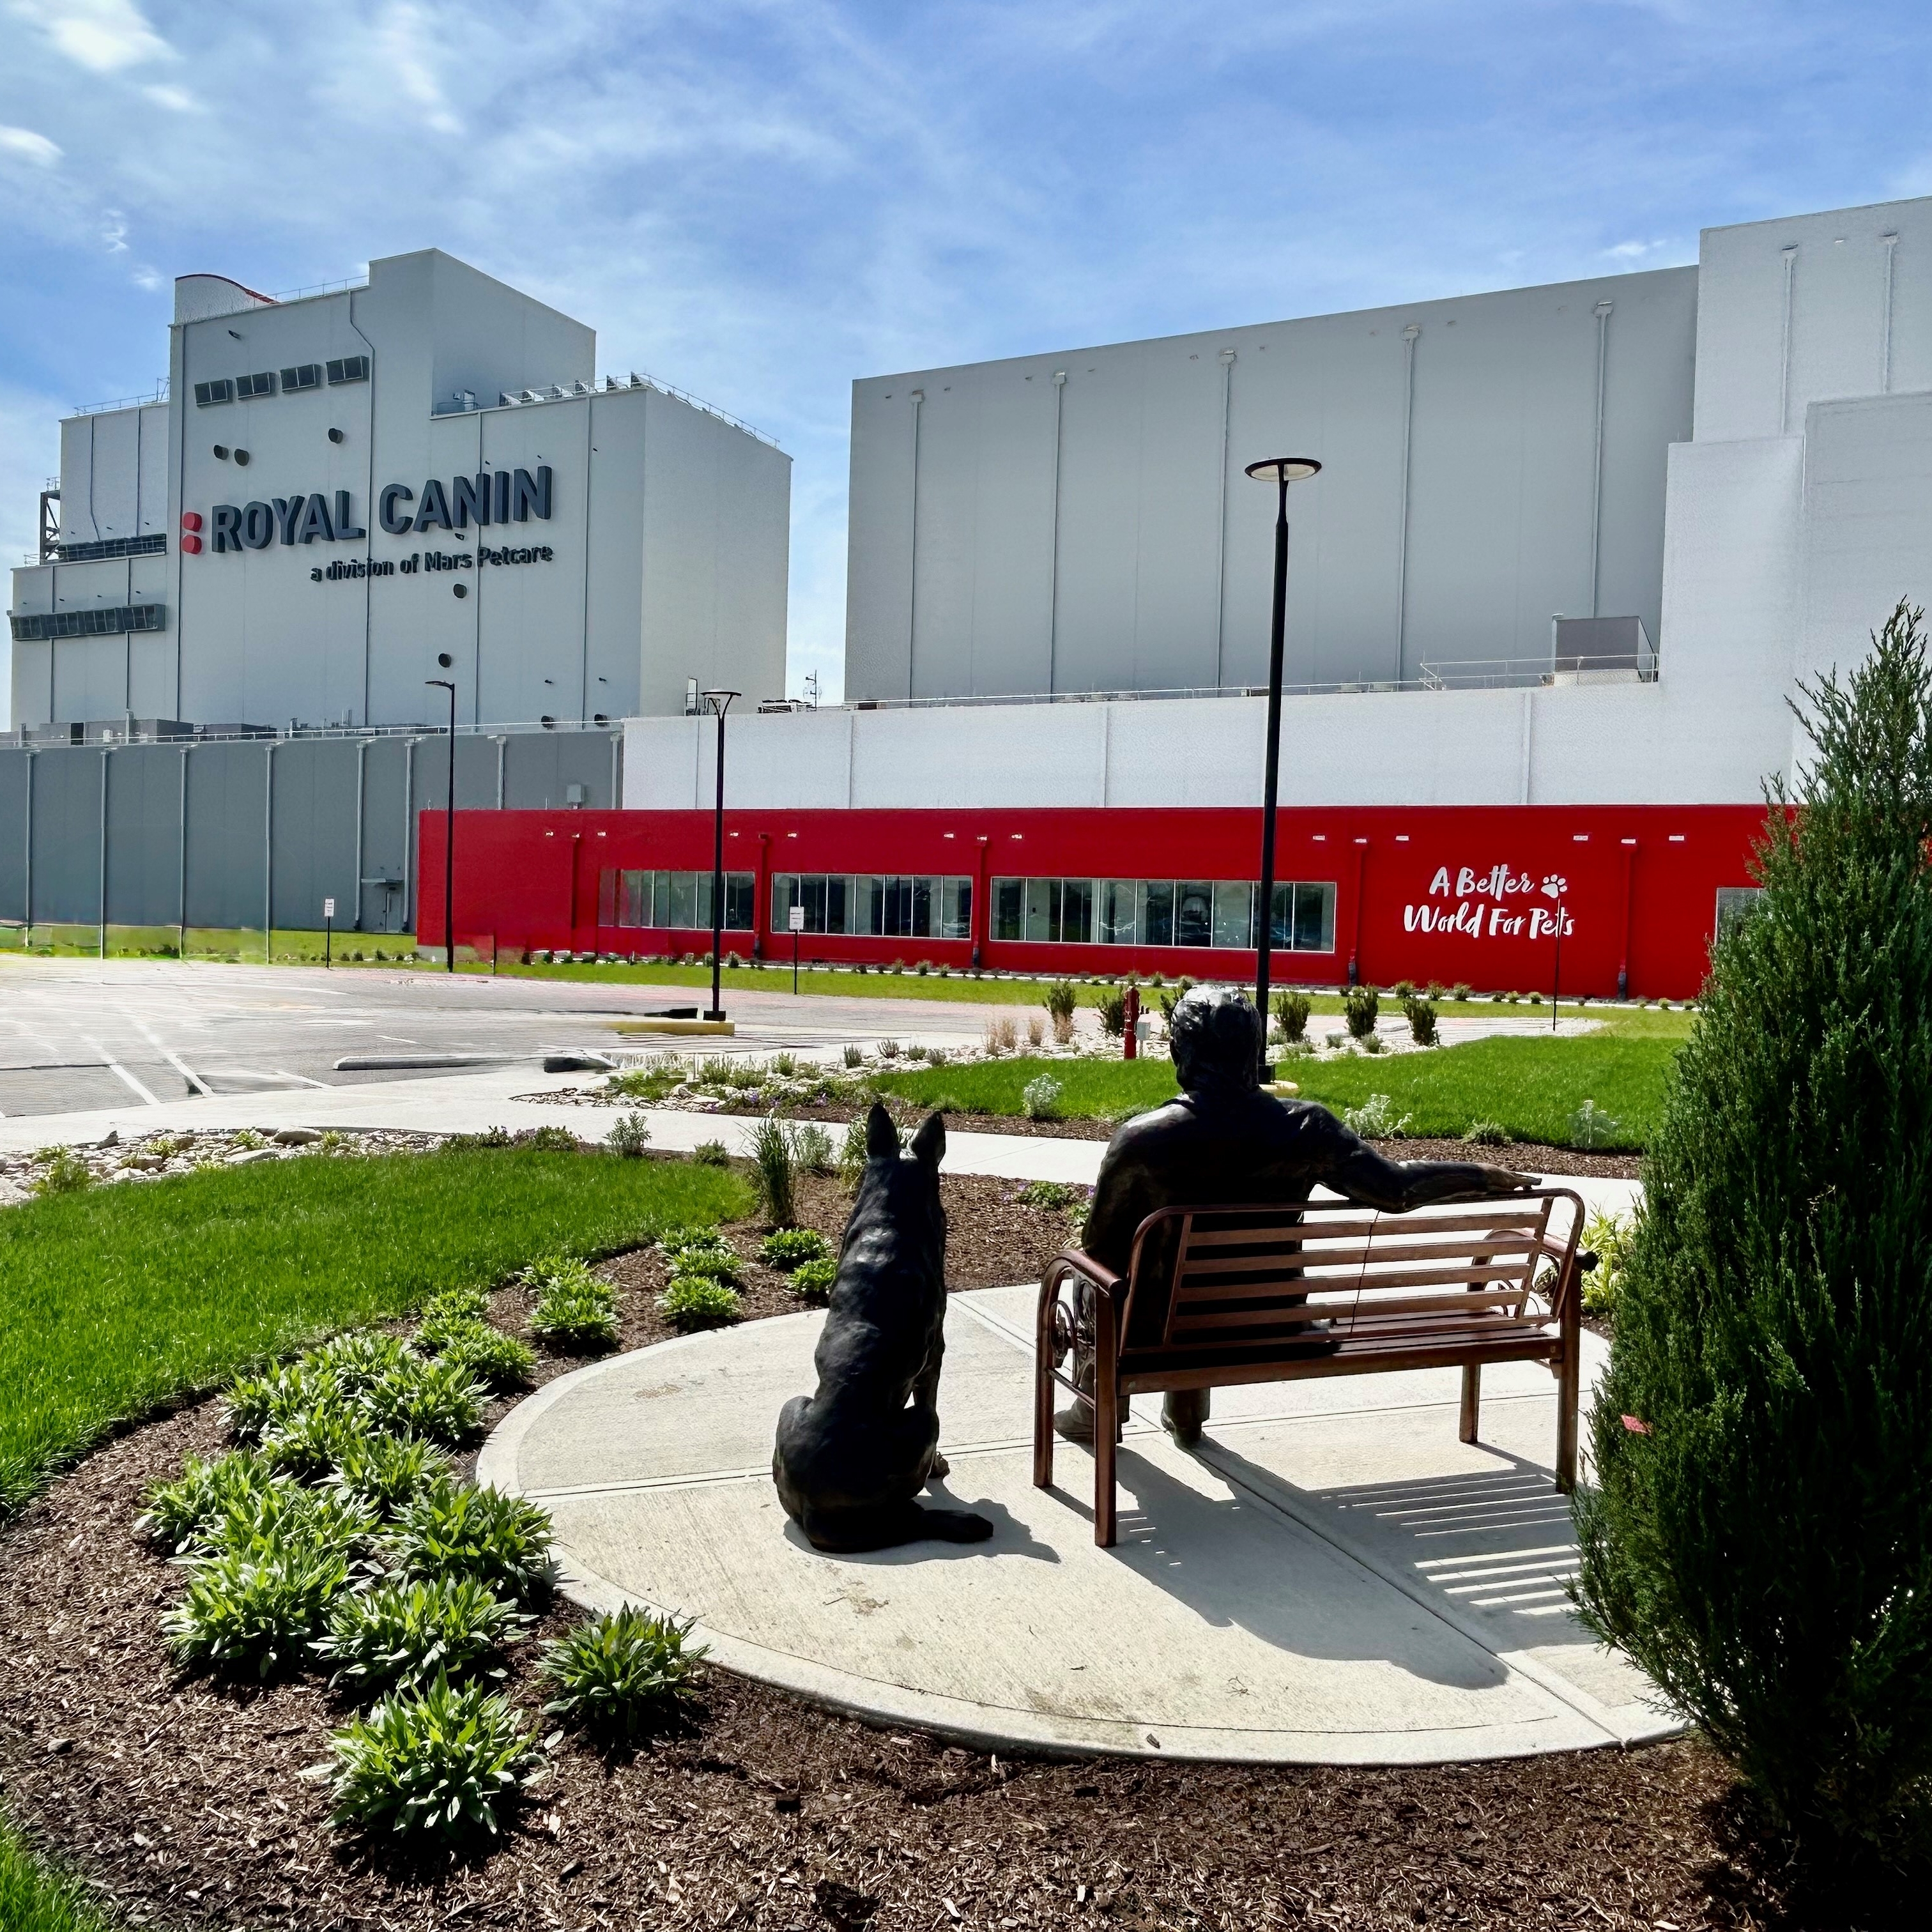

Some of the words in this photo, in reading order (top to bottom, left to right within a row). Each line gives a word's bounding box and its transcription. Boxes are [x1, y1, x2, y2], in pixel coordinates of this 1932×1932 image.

[211, 490, 366, 553] ROYAL
[379, 466, 552, 534] CANIN
[310, 566, 323, 582] a
[326, 558, 394, 581] division
[399, 553, 420, 574] of
[424, 551, 473, 572] Mars
[478, 546, 553, 567] Petcare
[1429, 866, 1450, 897] A
[1456, 864, 1534, 901] Better
[1404, 901, 1485, 938] World
[1489, 908, 1526, 936] For
[1529, 907, 1575, 939] Pets
